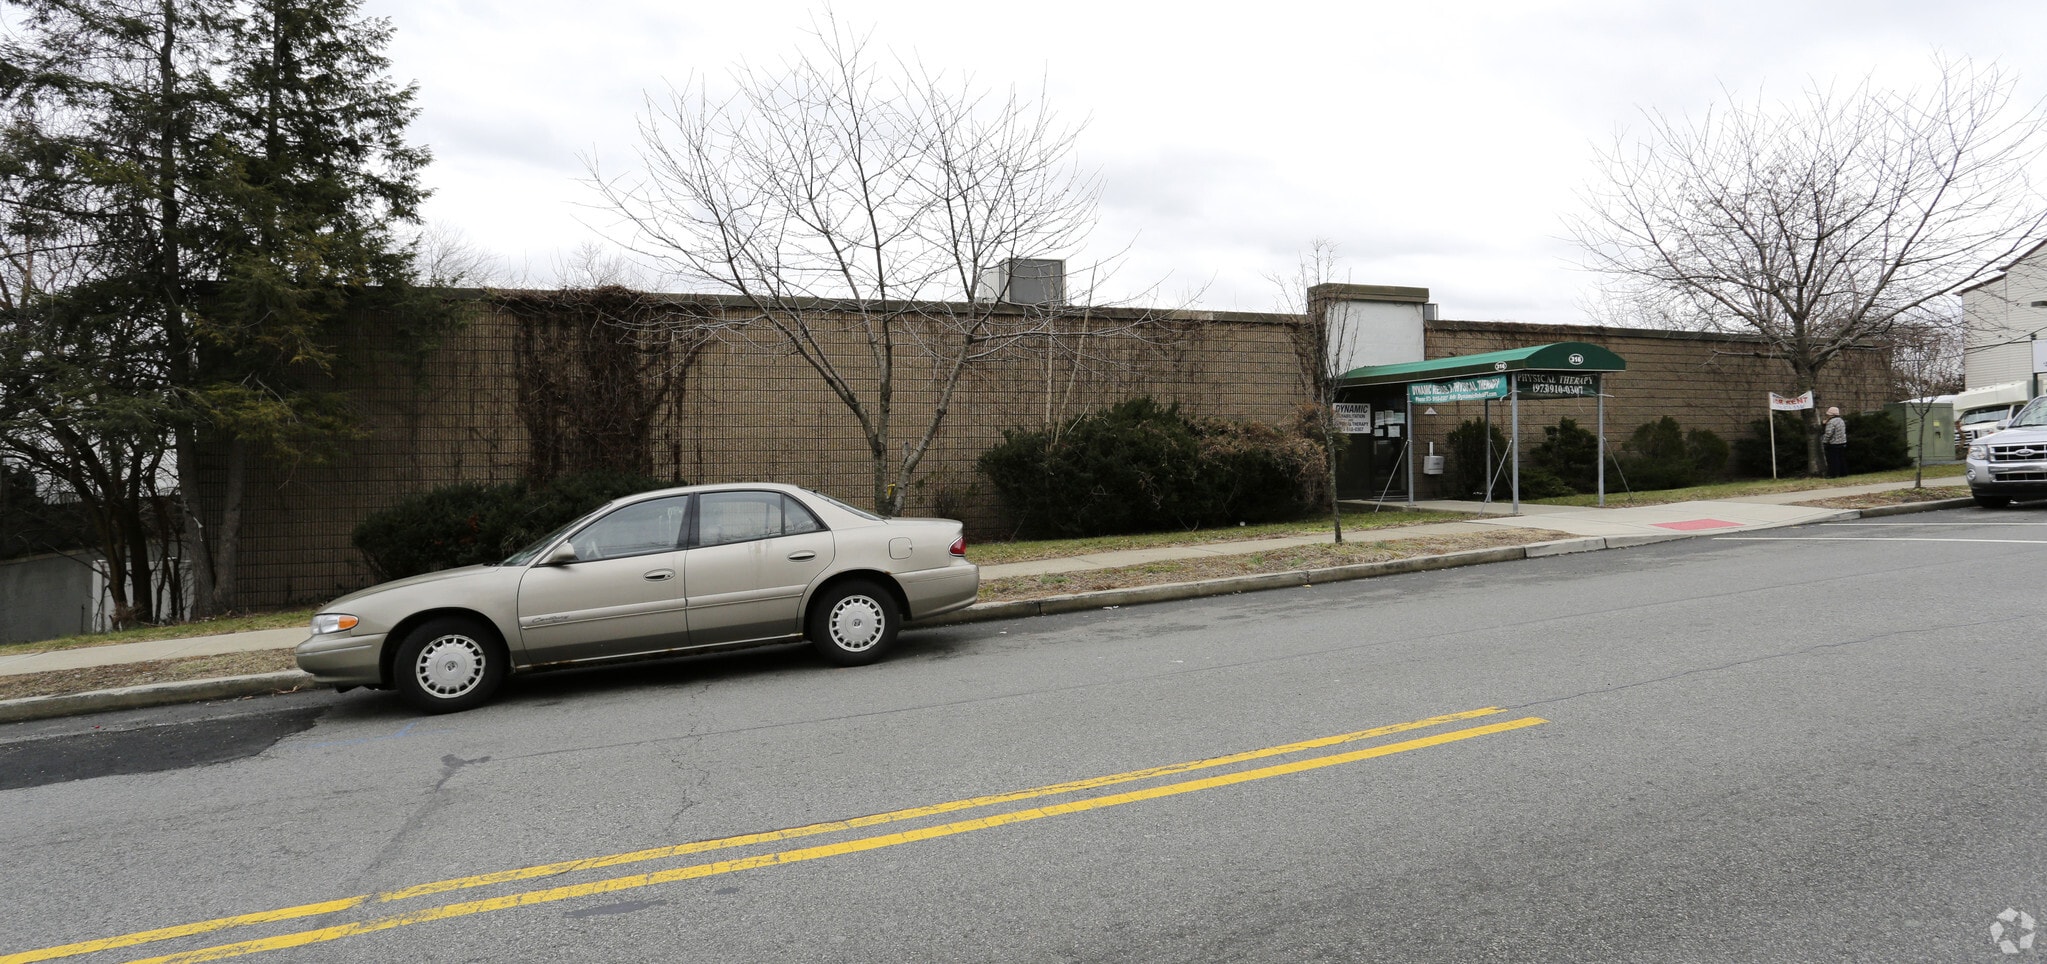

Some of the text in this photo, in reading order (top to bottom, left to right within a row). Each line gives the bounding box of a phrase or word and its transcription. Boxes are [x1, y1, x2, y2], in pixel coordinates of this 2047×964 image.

[1517, 374, 1593, 385] PHYSICAL THERAPY
[1412, 385, 1432, 395] DYNAMIC
[1453, 380, 1477, 393] PHYSICAL
[1477, 377, 1500, 391] THERAPY
[1335, 404, 1369, 414] DYNAMIC
